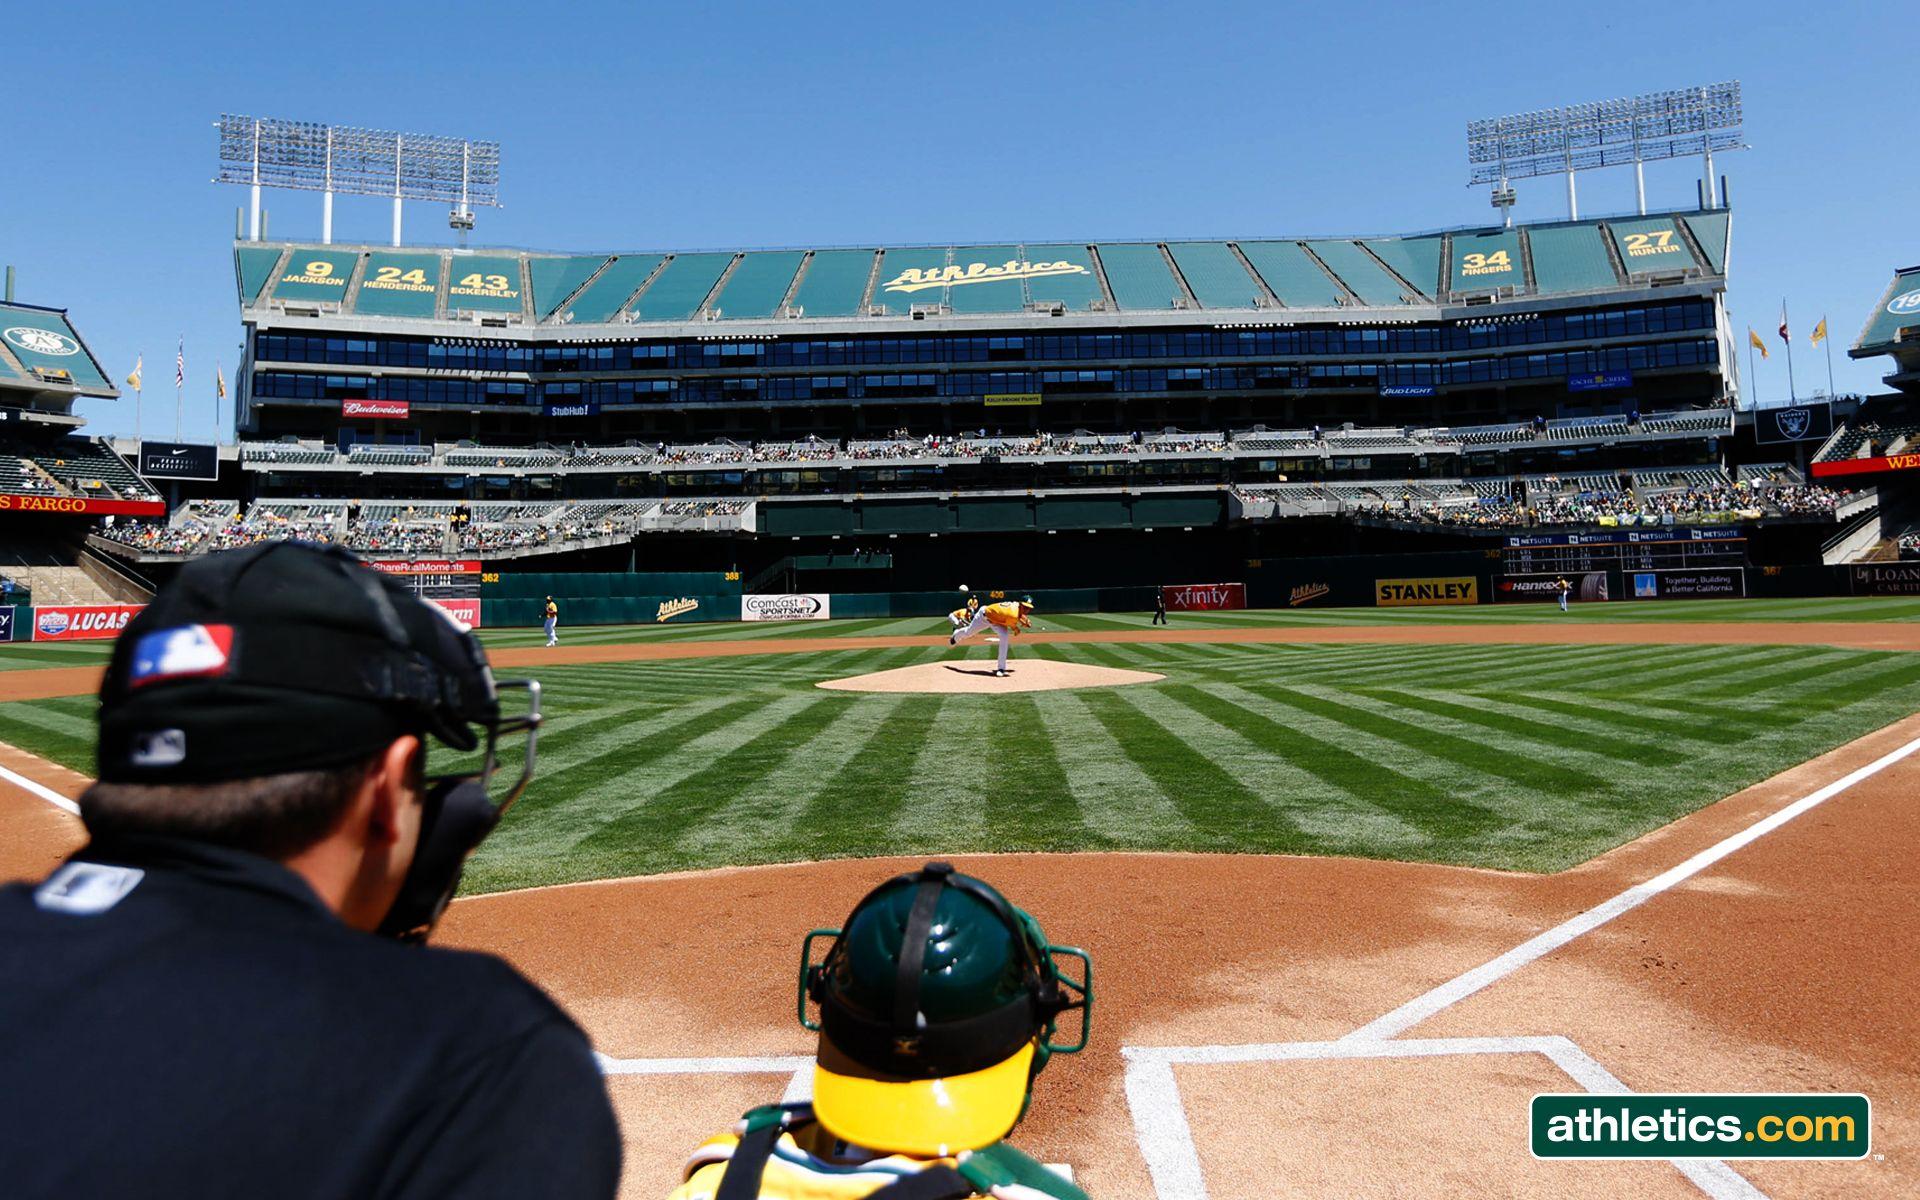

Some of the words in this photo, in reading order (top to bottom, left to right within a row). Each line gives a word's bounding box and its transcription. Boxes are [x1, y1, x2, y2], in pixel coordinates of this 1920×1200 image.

[1624, 231, 1673, 250] 27
[1629, 244, 1681, 257] HUNTER
[1463, 250, 1510, 268] 34
[304, 261, 333, 277] 9
[375, 266, 427, 285] 24
[882, 260, 1085, 292] Athletics
[1462, 264, 1512, 276] FINGERS
[282, 275, 344, 286] JACKSON
[363, 281, 435, 293] HENDERSON
[460, 273, 509, 290] 43
[451, 287, 518, 299] ECKERSLEY
[343, 403, 408, 415] Budweiser
[551, 404, 588, 417] StubHub!
[19, 496, 86, 512] FARGO
[482, 573, 499, 582] 362
[1174, 587, 1229, 608] xfinity
[1380, 583, 1472, 600] STANLEY
[656, 596, 699, 622] Athletics
[760, 607, 811, 615] SPORTSNET
[69, 612, 131, 631] LUCAS
